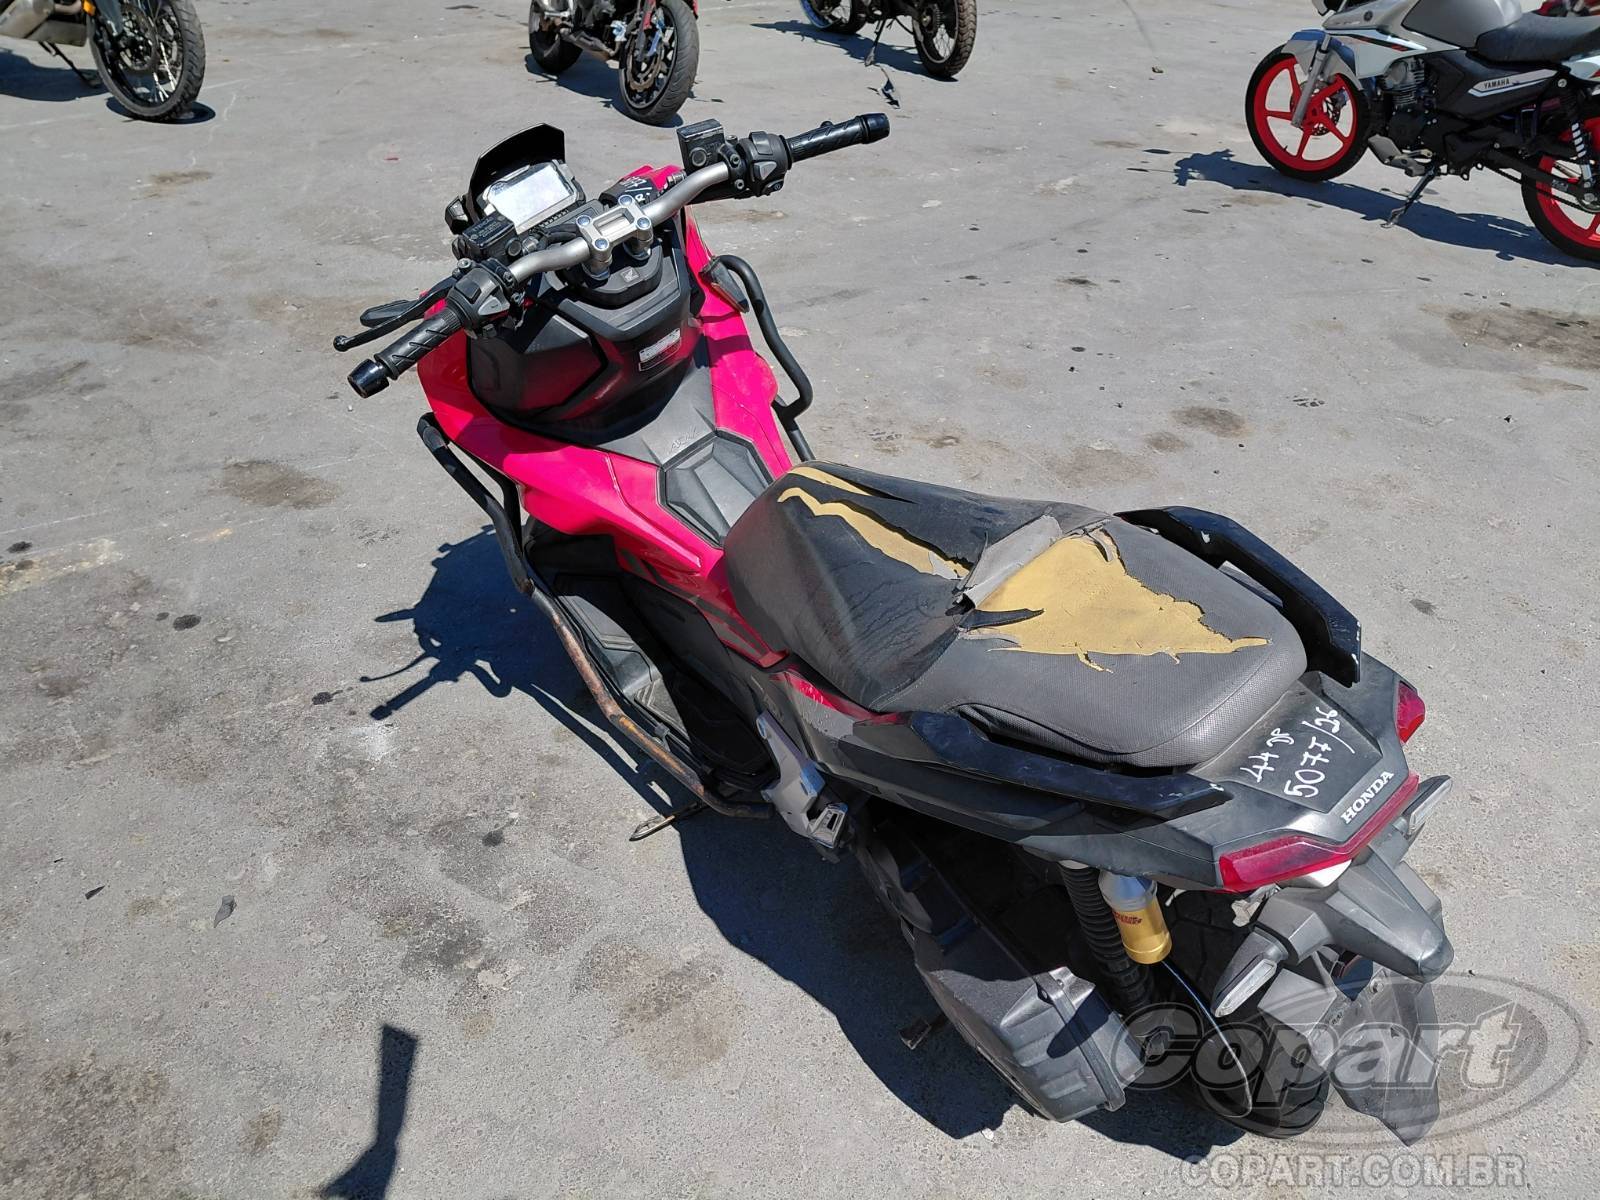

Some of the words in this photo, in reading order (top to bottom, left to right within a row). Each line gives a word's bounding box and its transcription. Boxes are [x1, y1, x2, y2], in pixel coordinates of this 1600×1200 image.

[1484, 77, 1510, 89] YAMAHA
[1240, 752, 1279, 782] 44
[1340, 770, 1395, 824] HONDA
